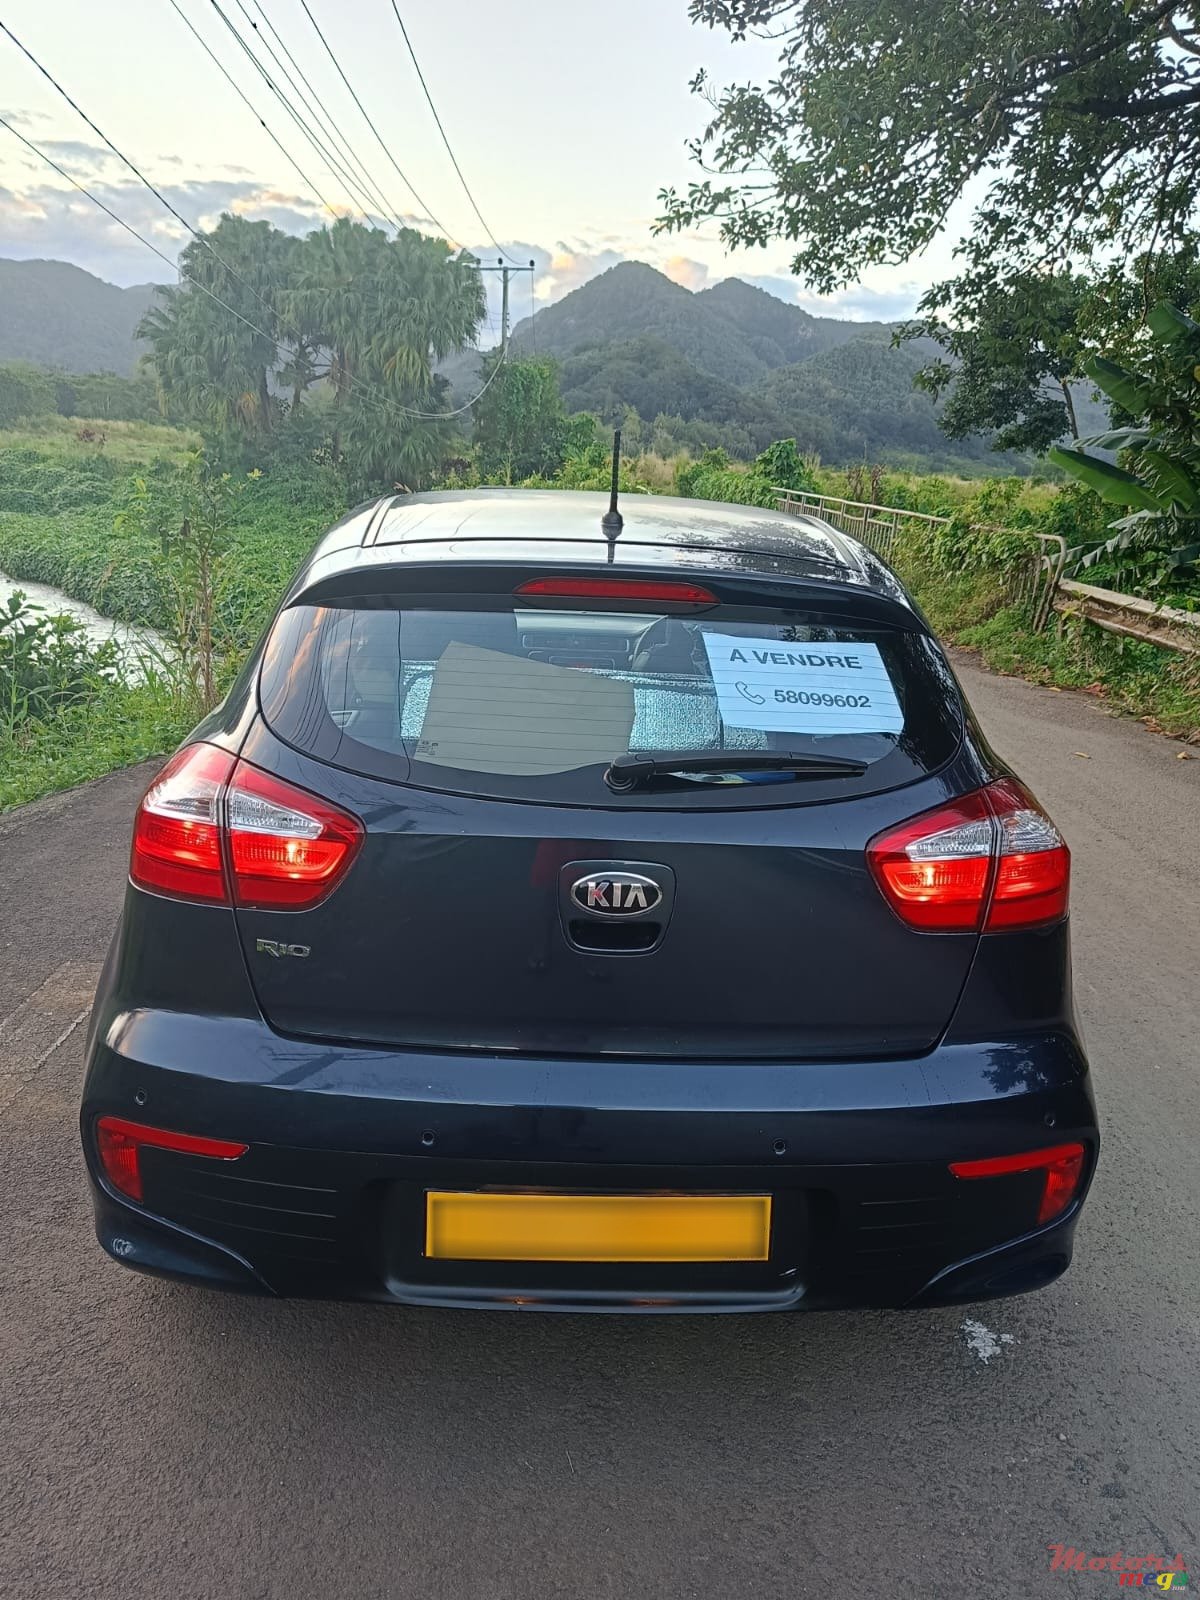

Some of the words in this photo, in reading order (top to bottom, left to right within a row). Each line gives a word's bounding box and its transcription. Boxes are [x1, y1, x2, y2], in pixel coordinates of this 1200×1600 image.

[729, 648, 748, 664] A
[752, 650, 863, 670] VENDRE
[774, 689, 872, 708] 58099602
[587, 881, 648, 908] KIA
[256, 938, 311, 958] RIO
